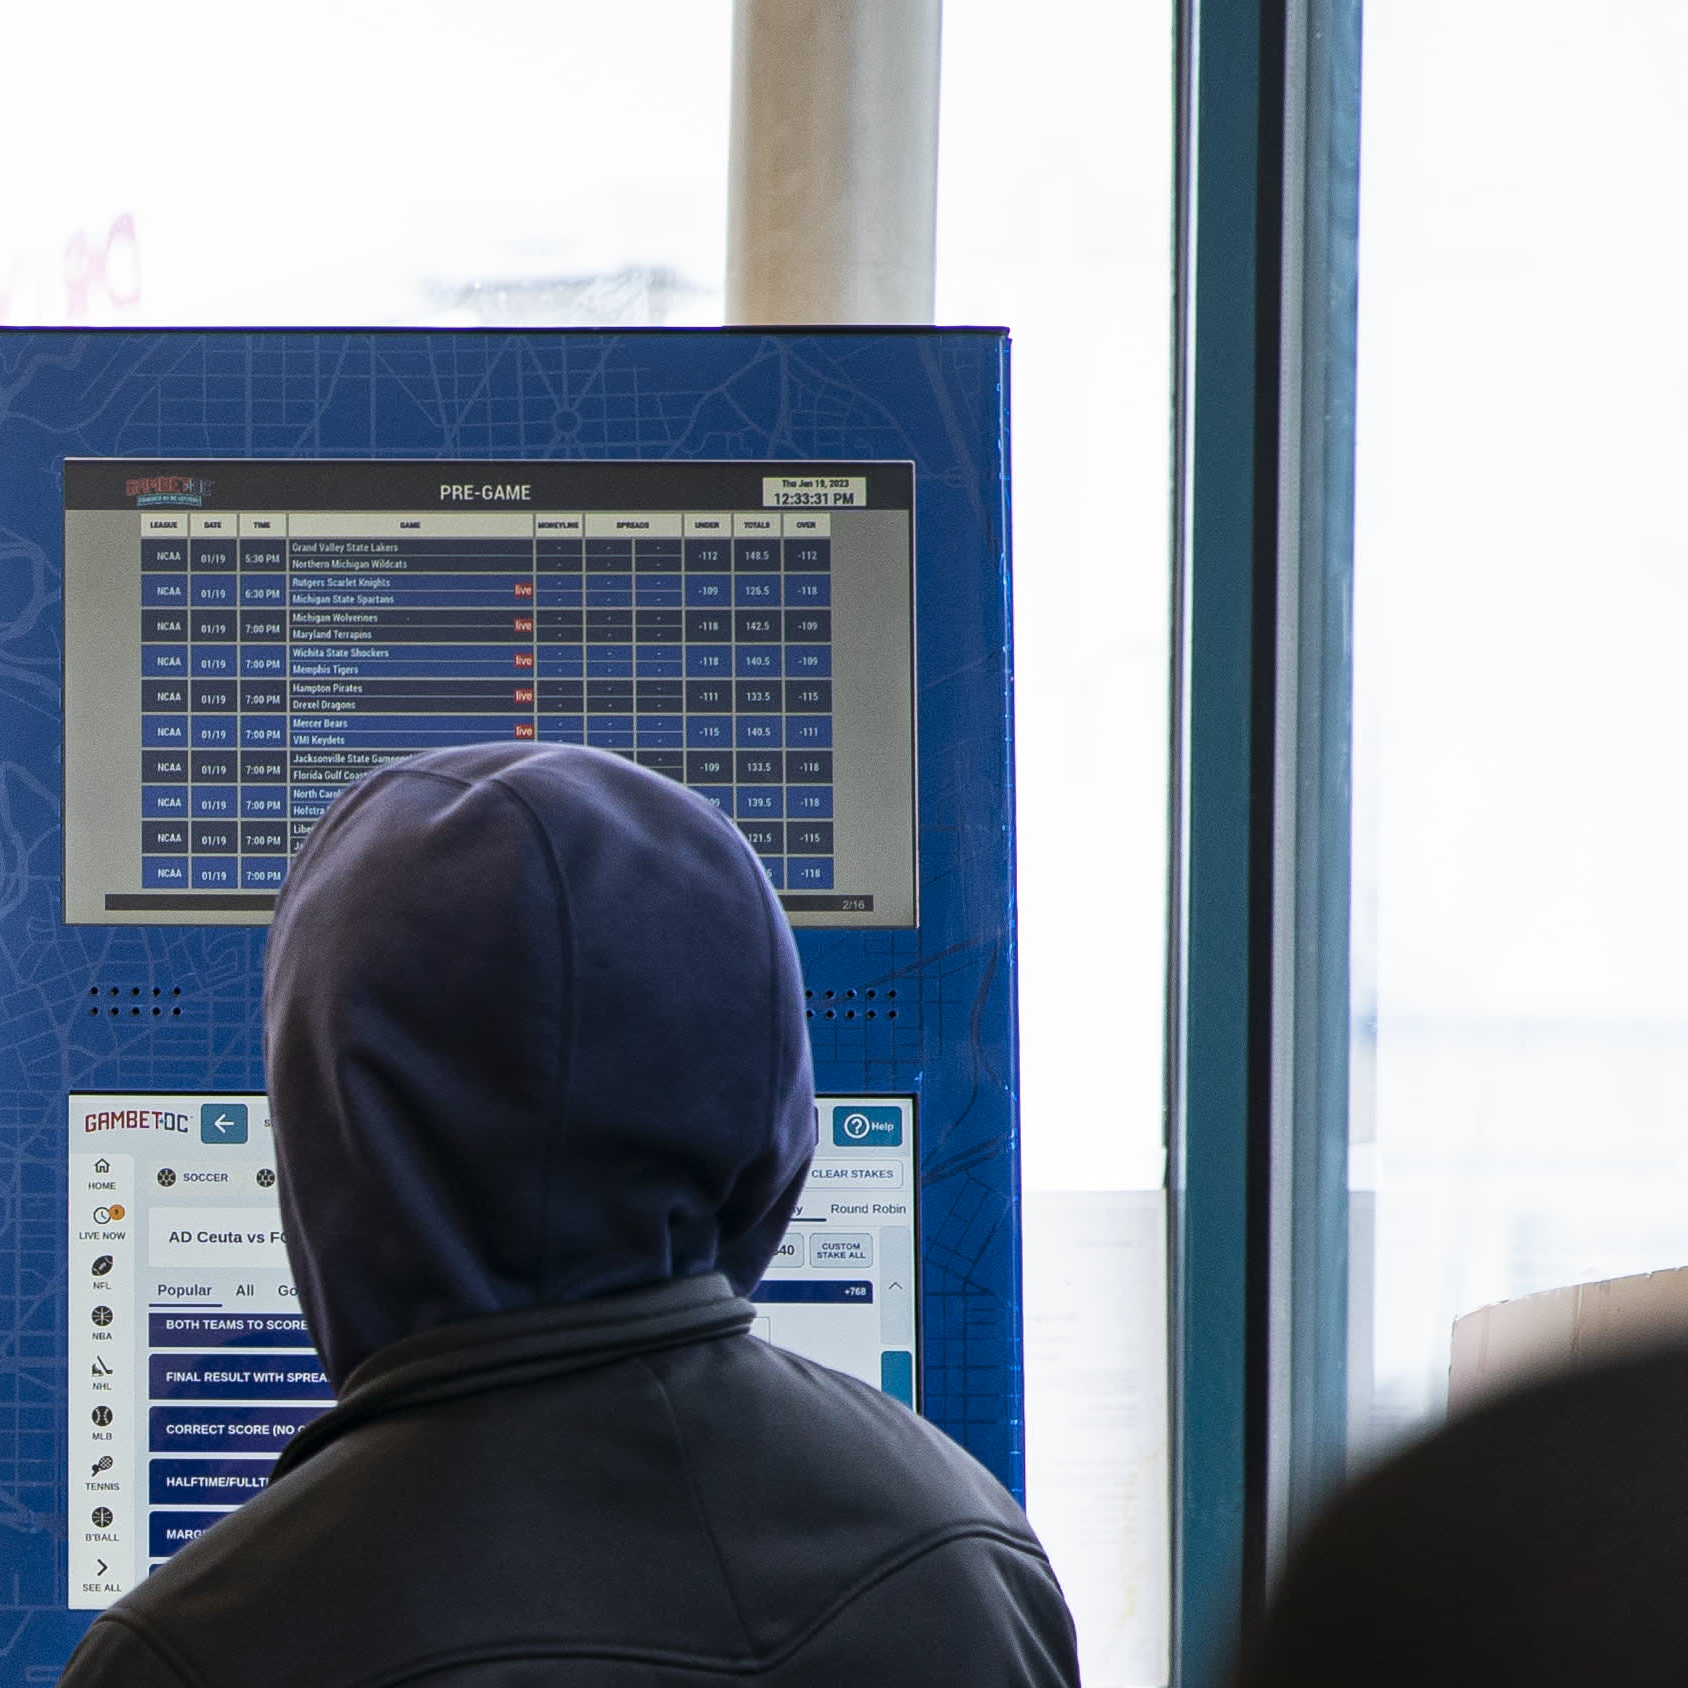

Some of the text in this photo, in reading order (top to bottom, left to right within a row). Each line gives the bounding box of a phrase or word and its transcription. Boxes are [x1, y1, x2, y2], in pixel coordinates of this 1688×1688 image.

[440, 485, 531, 500] PRE-GAME
[774, 493, 854, 505] 12:33:31 PM
[293, 543, 398, 554] Grand Valley State Lakers
[157, 551, 181, 561] NCAA
[328, 578, 390, 588] Scarlet Knights
[184, 1174, 228, 1182] SOCCER
[812, 1170, 893, 1178] CLEAR STAKES
[89, 1182, 116, 1190] HOME
[831, 1204, 906, 1213] Round Robin
[79, 1232, 125, 1240] LIVE NOW
[169, 1232, 265, 1243] AD Ceuta vs
[158, 1284, 212, 1298] Popular
[236, 1285, 254, 1296] All
[166, 1373, 283, 1382] FINAL RESULT WITH
[85, 1483, 119, 1491] TENNIS
